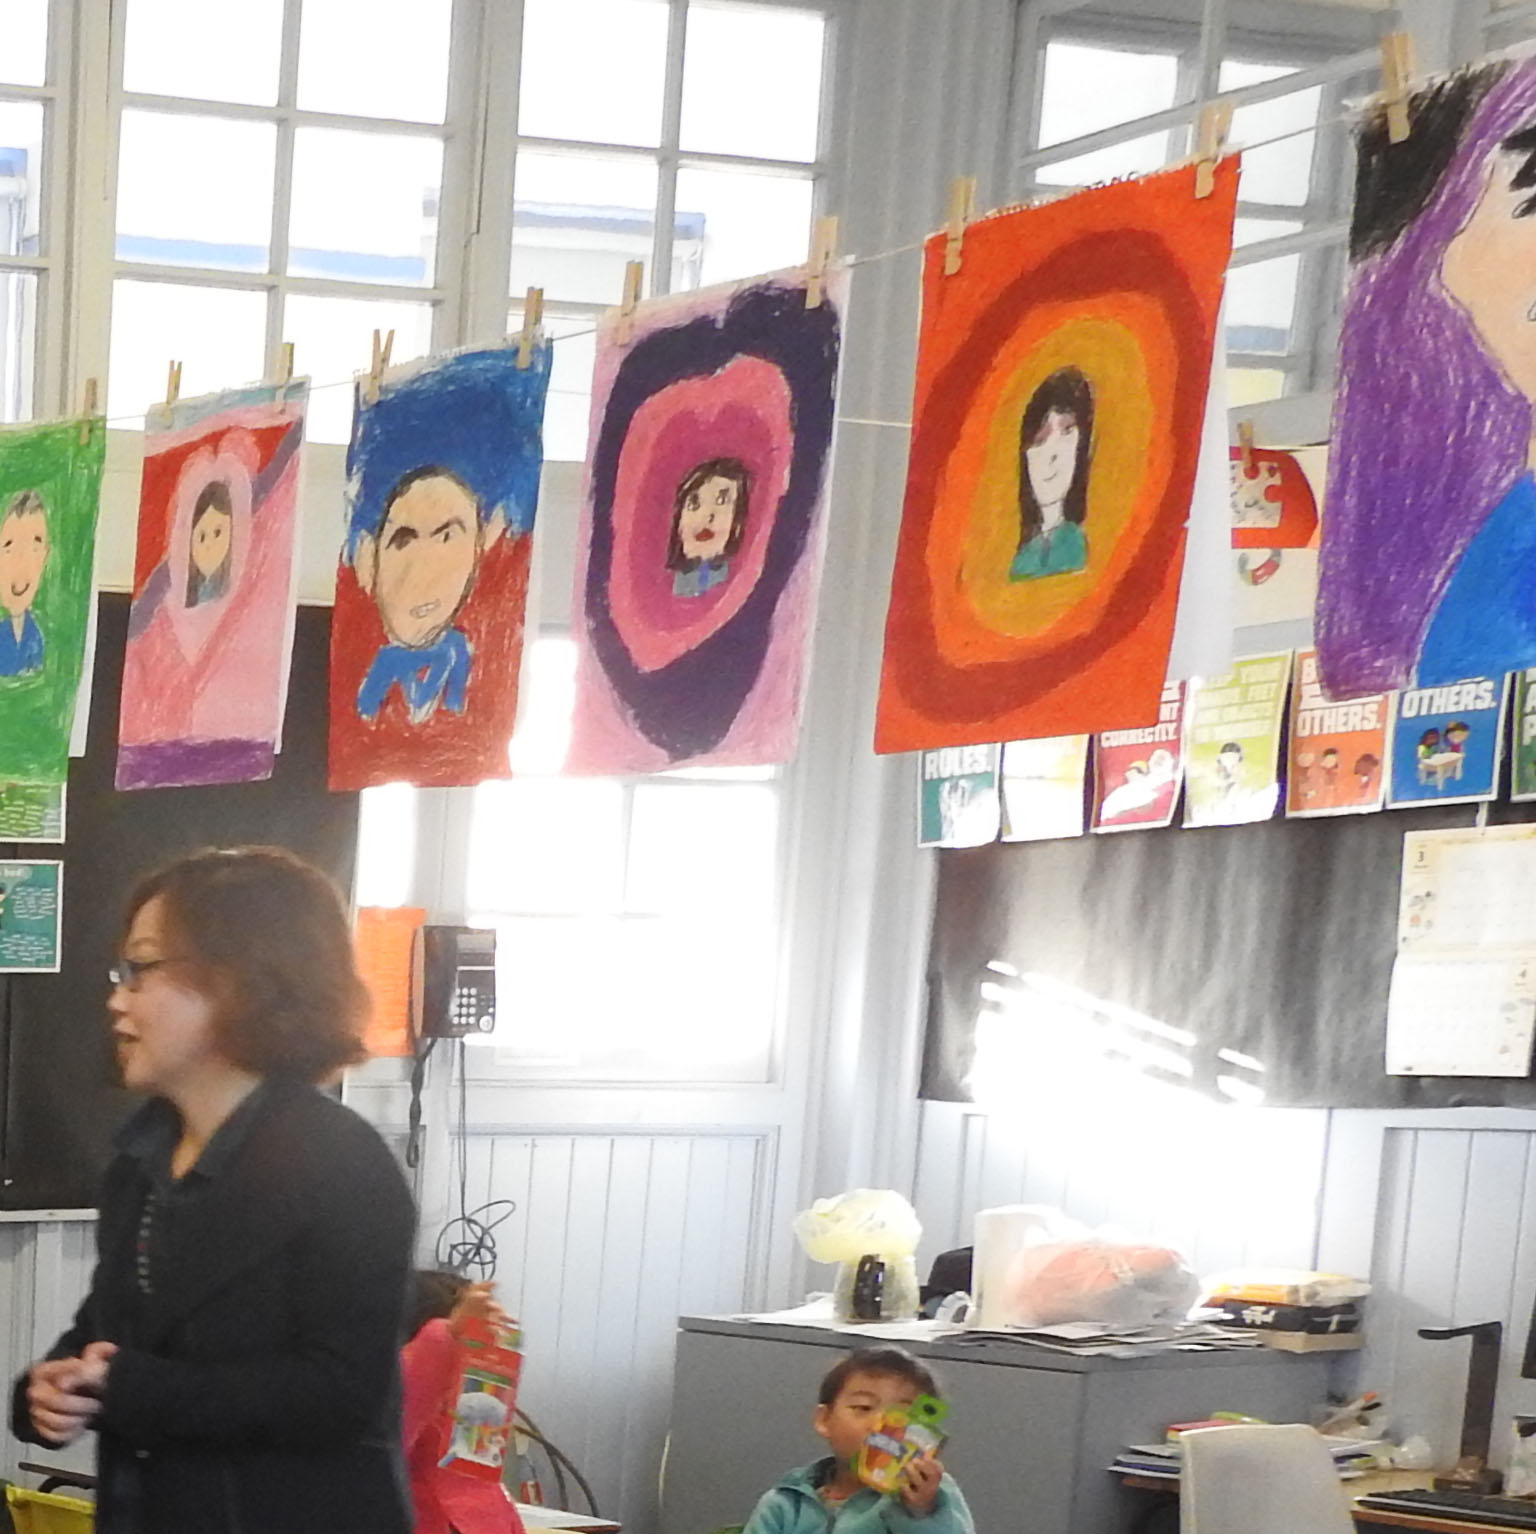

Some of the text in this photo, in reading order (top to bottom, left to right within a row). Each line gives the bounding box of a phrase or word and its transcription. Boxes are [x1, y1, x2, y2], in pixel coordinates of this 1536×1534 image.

[1401, 680, 1498, 718] OTHERS.
[1297, 710, 1381, 738] OTHERS.
[924, 742, 993, 781] RULES.
